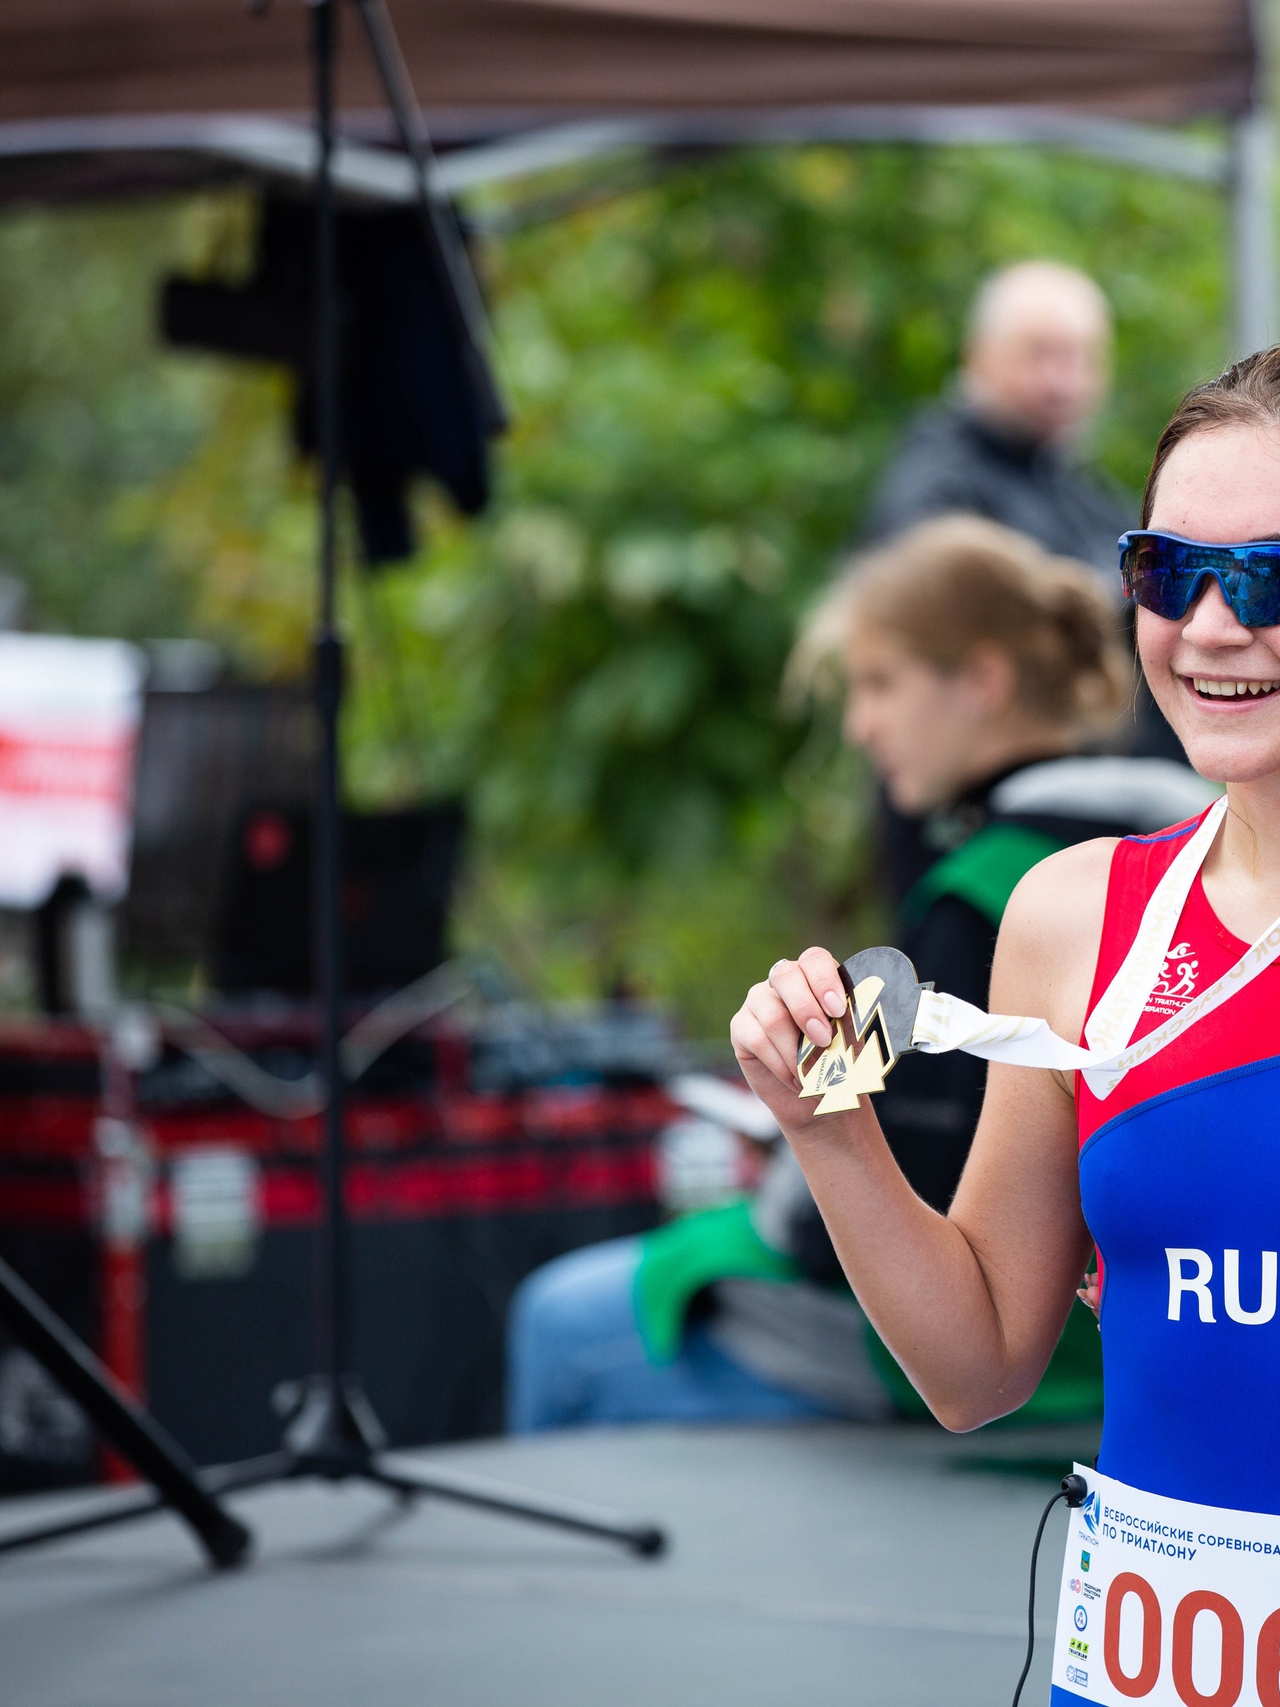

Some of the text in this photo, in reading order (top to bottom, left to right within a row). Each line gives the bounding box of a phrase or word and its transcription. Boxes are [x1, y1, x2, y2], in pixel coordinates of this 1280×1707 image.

[1102, 1523, 1197, 1561] ПО ТРИАТЛОНУ
[1104, 1506, 1194, 1543] ВСЕРОССИЙСКИЕ
